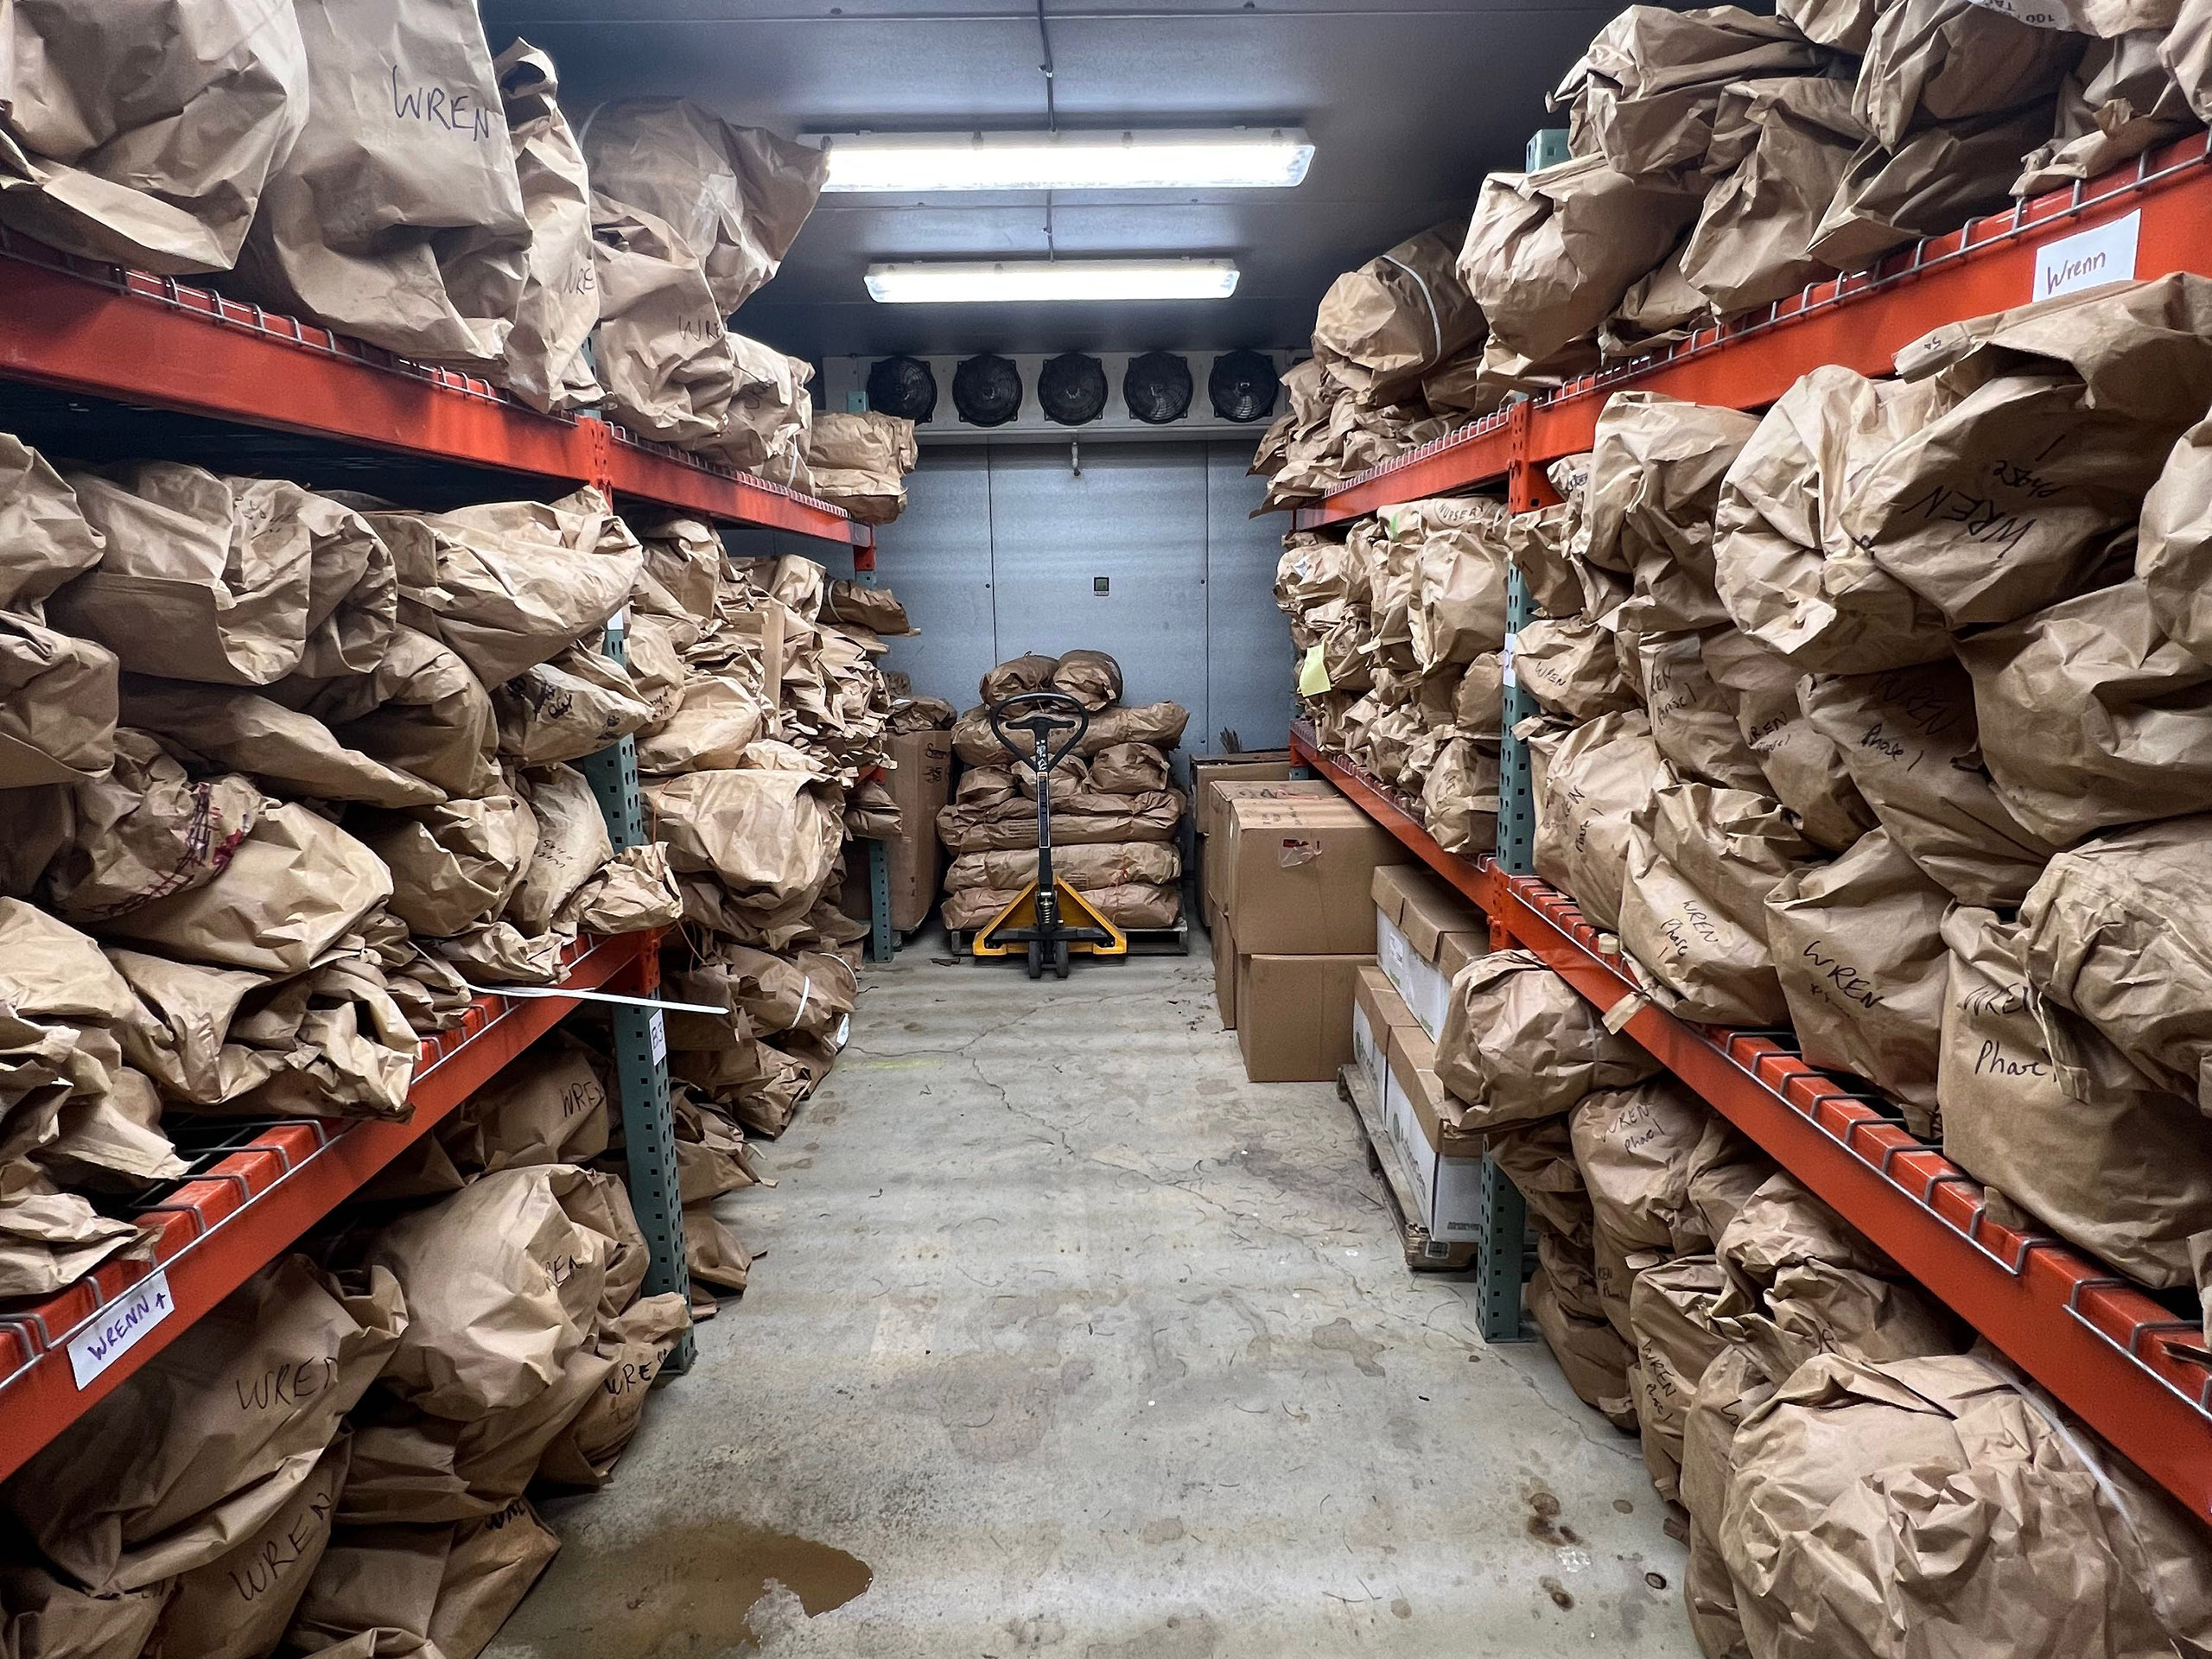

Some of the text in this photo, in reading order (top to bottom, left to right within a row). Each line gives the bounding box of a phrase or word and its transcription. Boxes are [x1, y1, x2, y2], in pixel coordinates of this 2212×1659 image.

[392, 64, 489, 142] WREN
[2047, 251, 2107, 296] Wrenn
[1438, 501, 1484, 522] NURSERY
[1901, 485, 2037, 559] WREN
[1535, 660, 1567, 688] WREN
[1682, 899, 1719, 943] WREN
[1803, 939, 1885, 1009] WREN
[87, 1294, 149, 1361] WRENN
[1642, 1339, 1677, 1398] WREN
[228, 1492, 334, 1601] WREN
